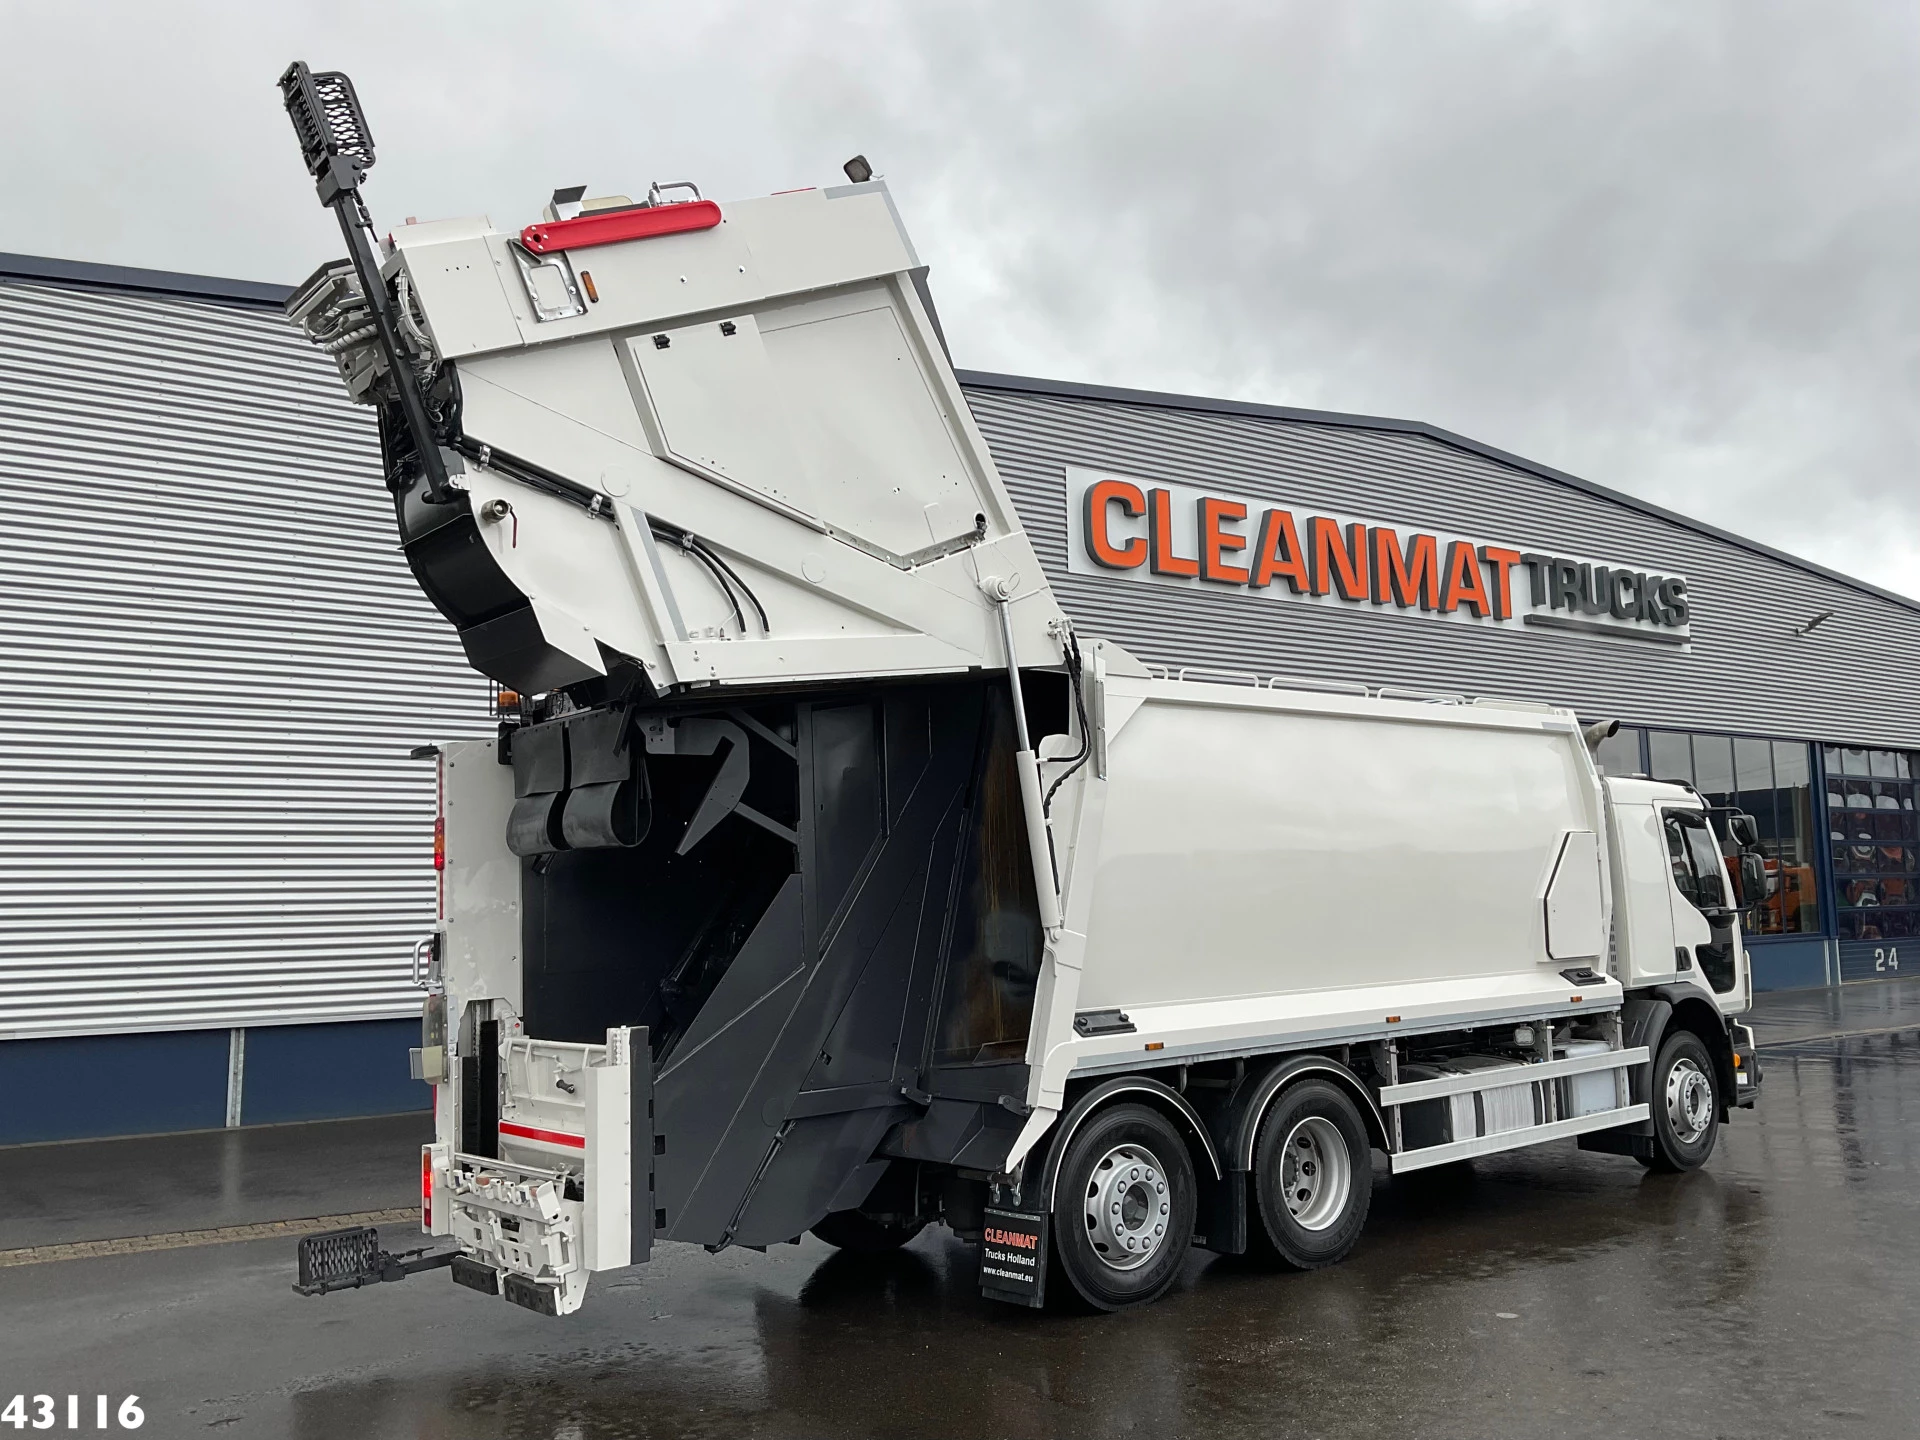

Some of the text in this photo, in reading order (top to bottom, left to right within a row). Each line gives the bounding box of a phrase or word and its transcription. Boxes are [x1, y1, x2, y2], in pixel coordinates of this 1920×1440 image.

[1083, 479, 1690, 626] CLEANMAT TRUCKS
[1874, 947, 1899, 972] 24
[984, 1227, 1038, 1249] CLEANMAT
[984, 1247, 1036, 1267] Trucks Holland
[983, 1266, 1034, 1282] www.cleanmat.eu
